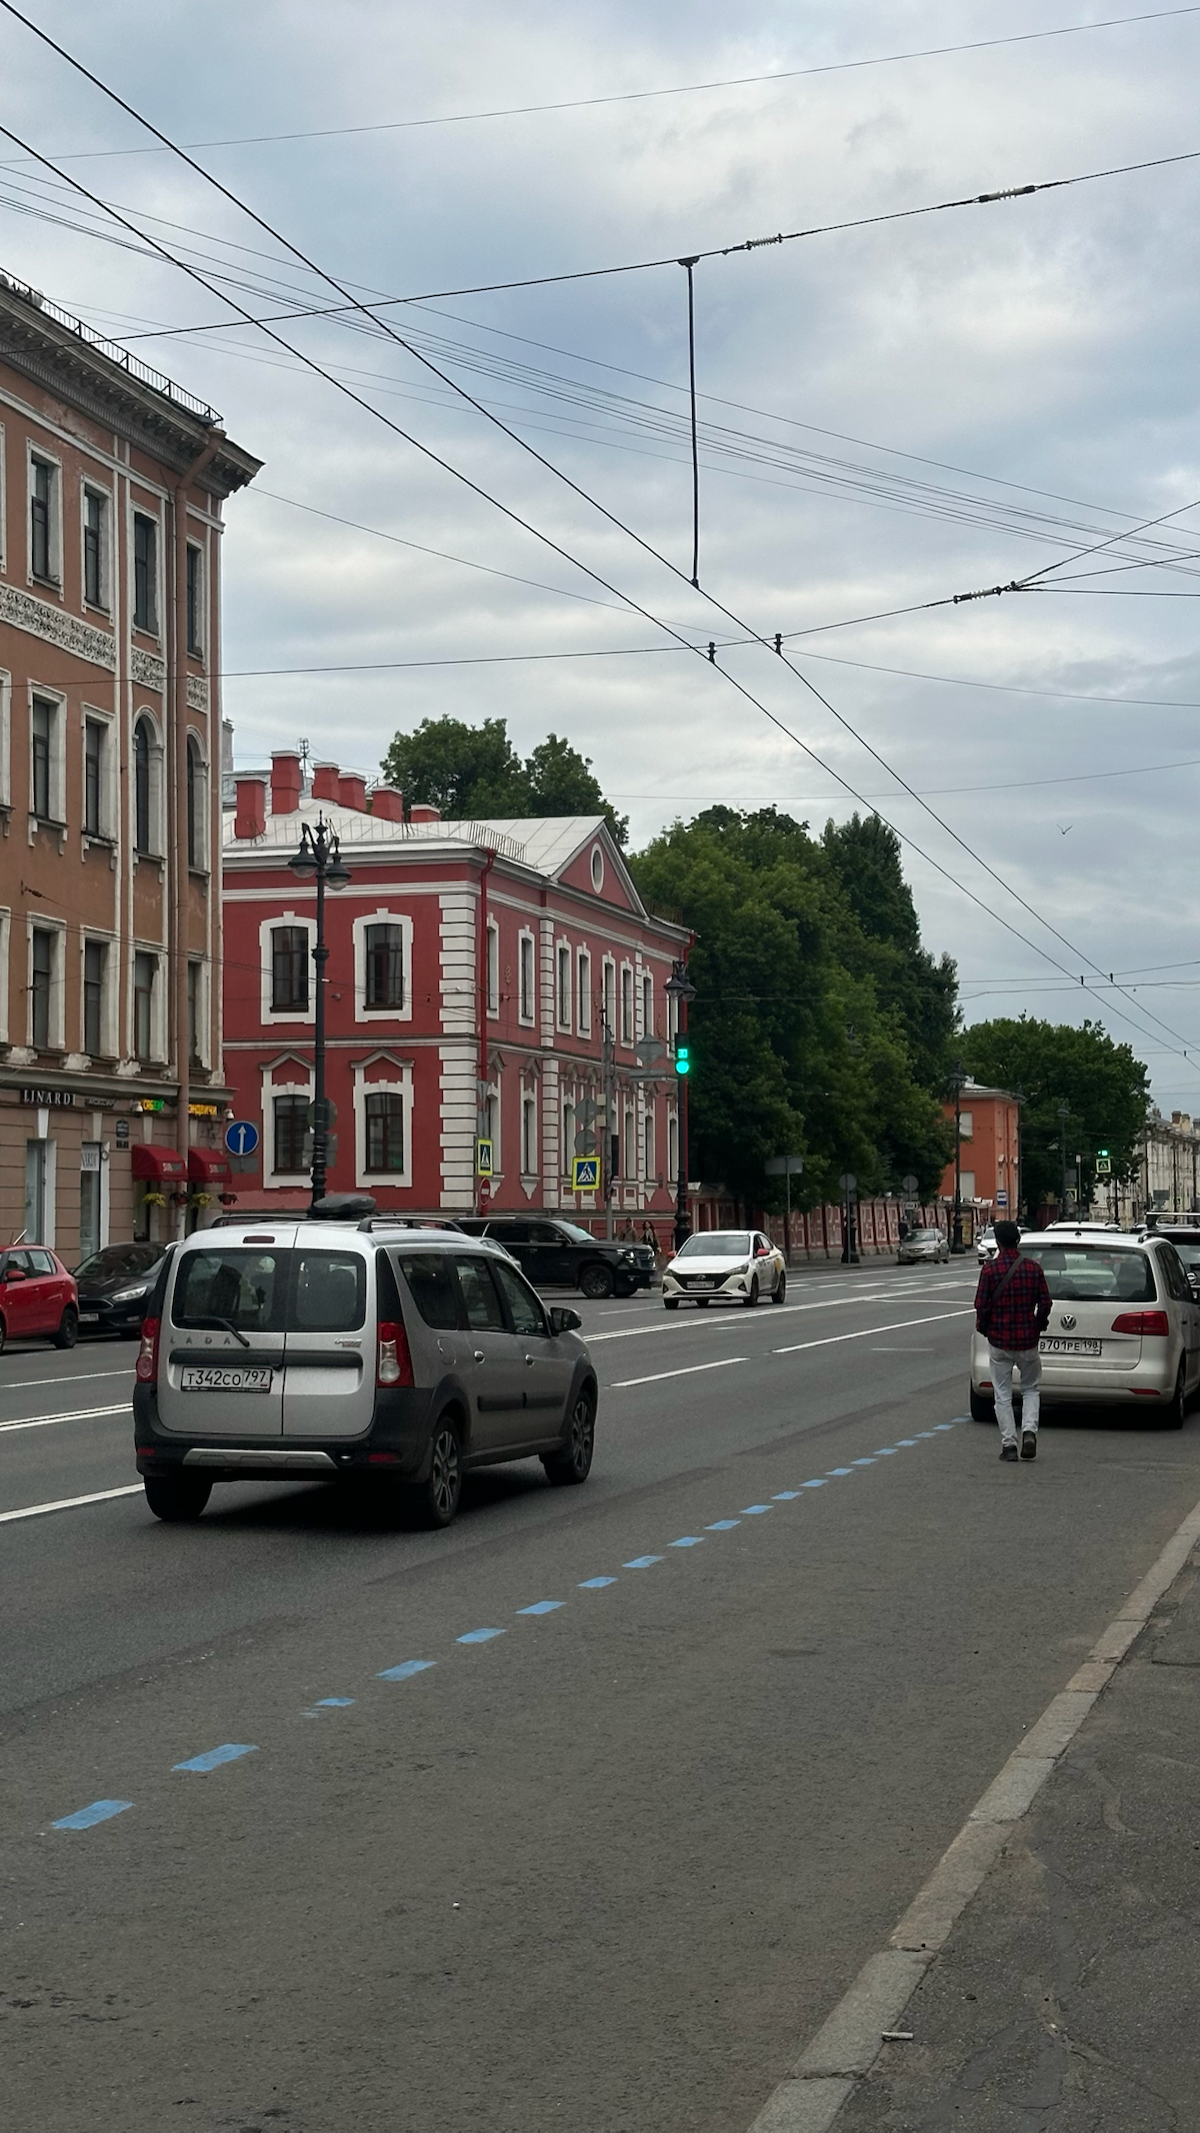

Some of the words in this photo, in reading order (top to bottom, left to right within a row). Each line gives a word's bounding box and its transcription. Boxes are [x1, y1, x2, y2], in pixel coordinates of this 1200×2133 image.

[24, 1088, 76, 1106] LINARDI
[187, 1103, 218, 1116] ЭНДВИЧИ
[170, 1336, 232, 1345] LADA
[1083, 1340, 1099, 1349] 198
[244, 1370, 266, 1383] 797
